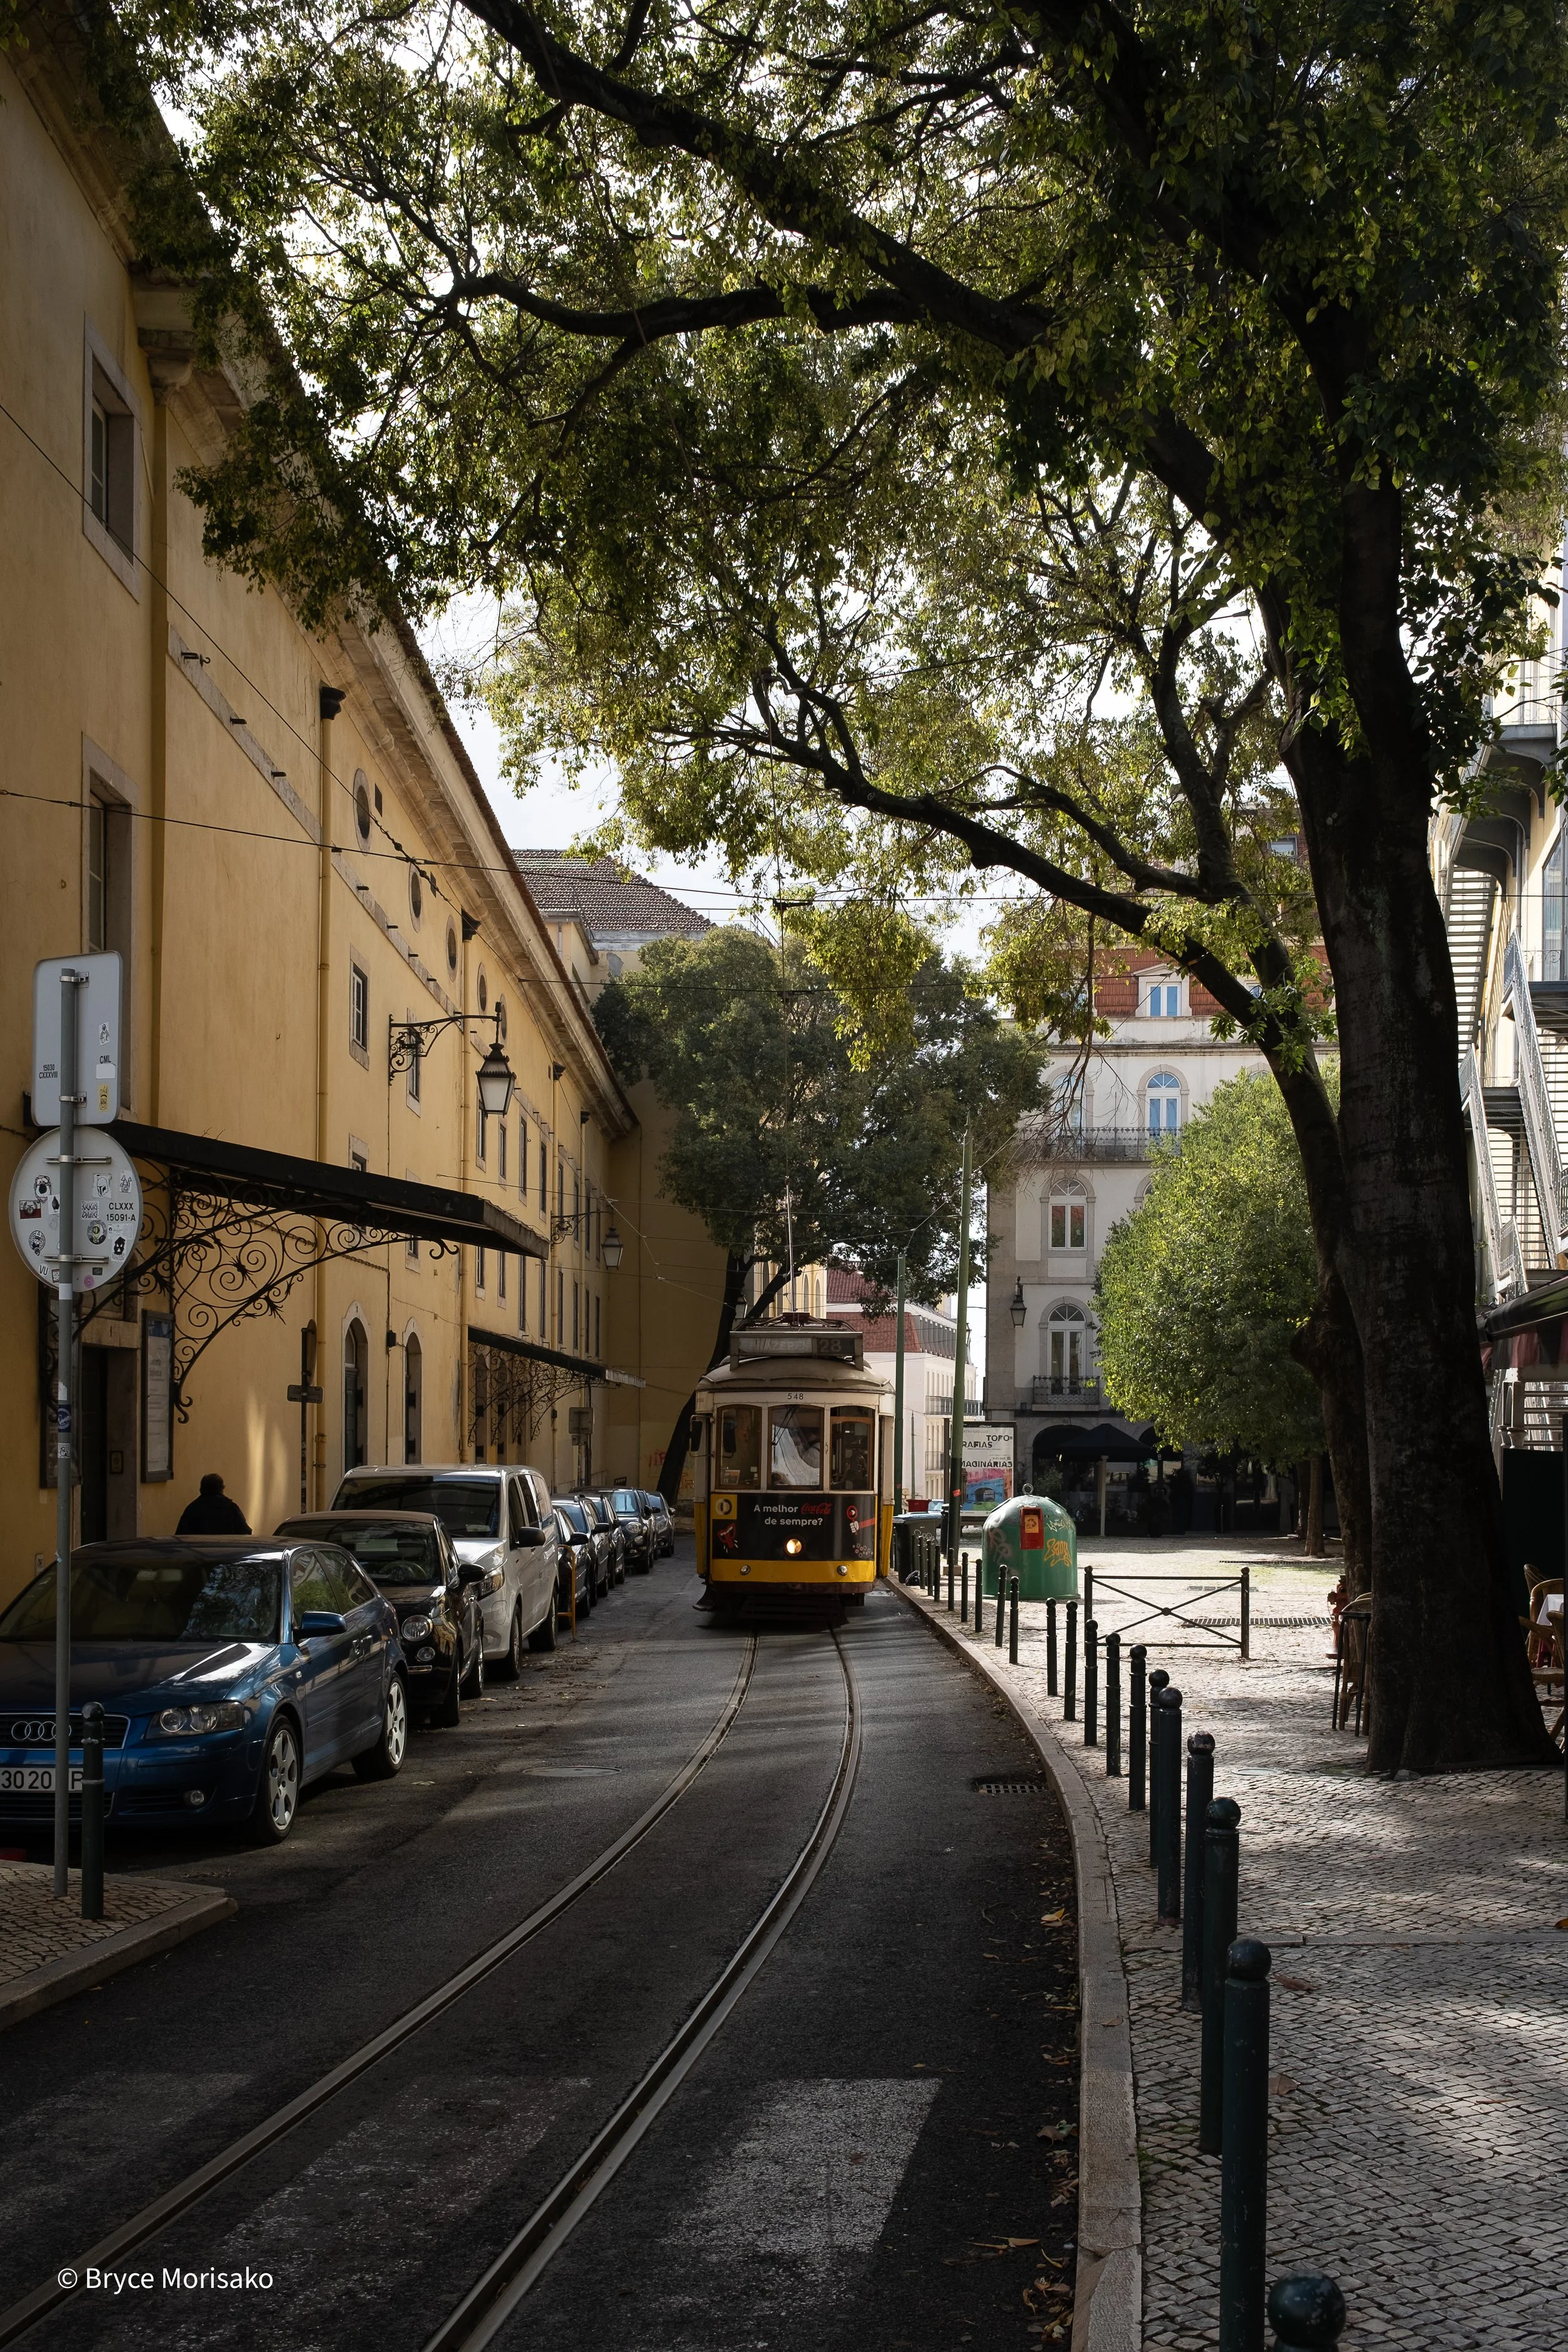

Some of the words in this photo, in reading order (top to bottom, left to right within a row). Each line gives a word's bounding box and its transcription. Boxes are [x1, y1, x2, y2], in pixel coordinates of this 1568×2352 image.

[100, 1055, 111, 1064] CML
[109, 1202, 134, 1210] CLXXX
[819, 1338, 842, 1353] 28
[787, 1392, 805, 1401] 548
[754, 1504, 761, 1512] A
[763, 1504, 798, 1513] melhor
[764, 1517, 777, 1525] de
[780, 1517, 824, 1527] sempre?
